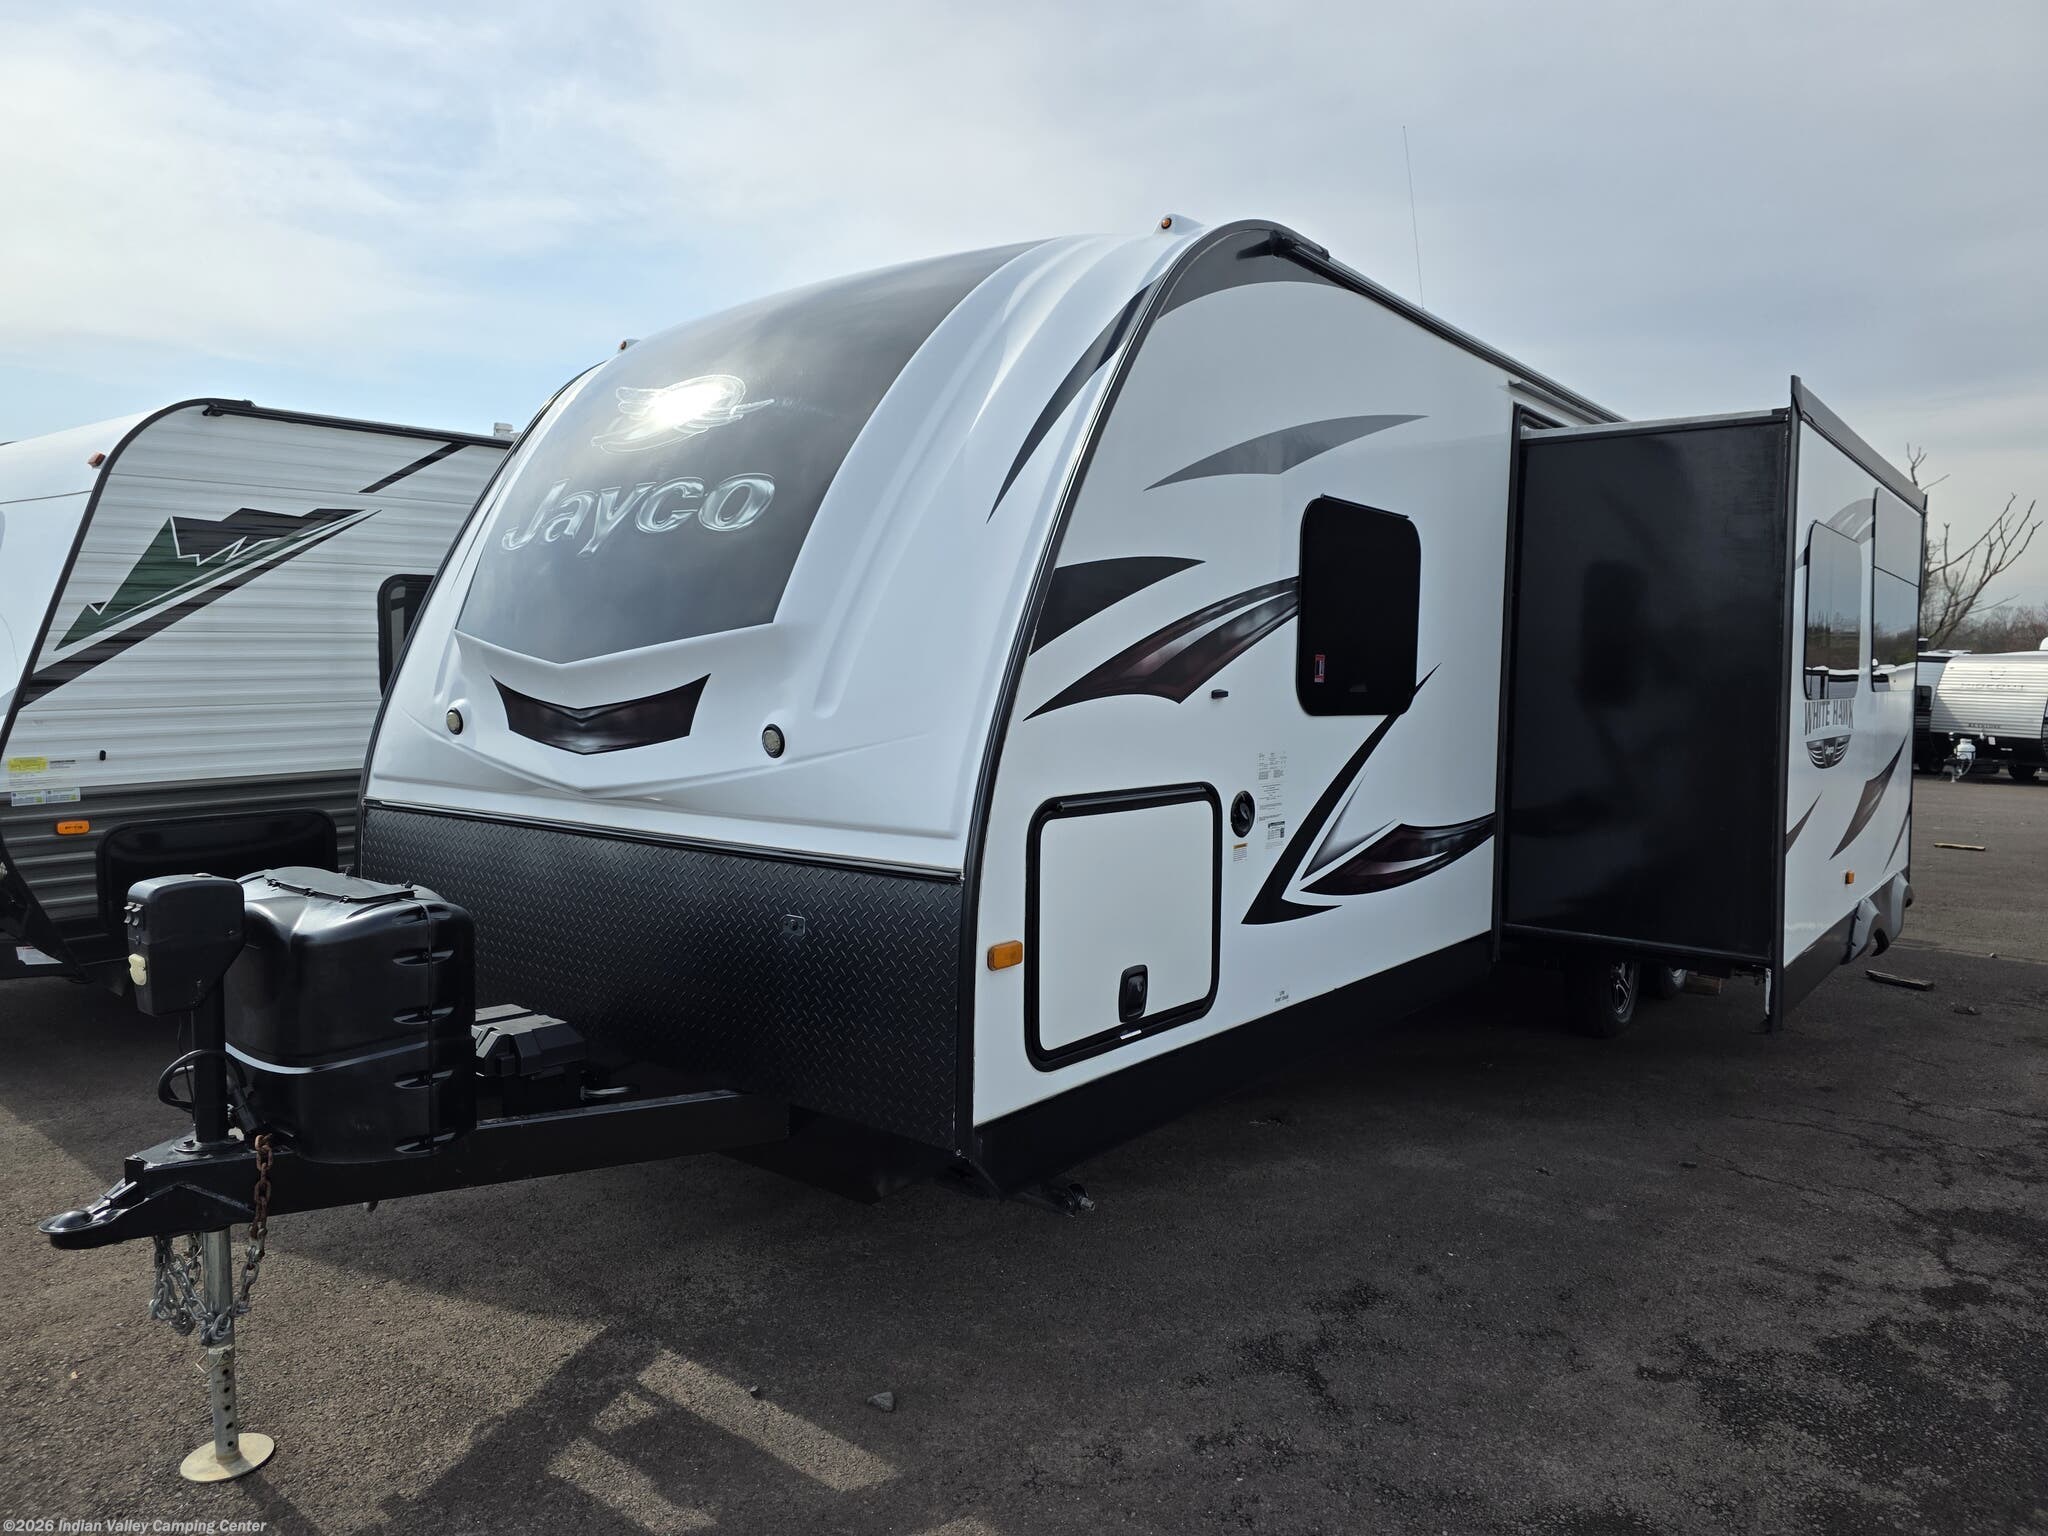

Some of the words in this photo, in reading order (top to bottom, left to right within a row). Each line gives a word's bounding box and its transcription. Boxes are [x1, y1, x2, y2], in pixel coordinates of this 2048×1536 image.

[501, 472, 776, 557] Jayco
[1804, 701, 1830, 736] WHITE
[1832, 699, 1855, 729] HAWK
